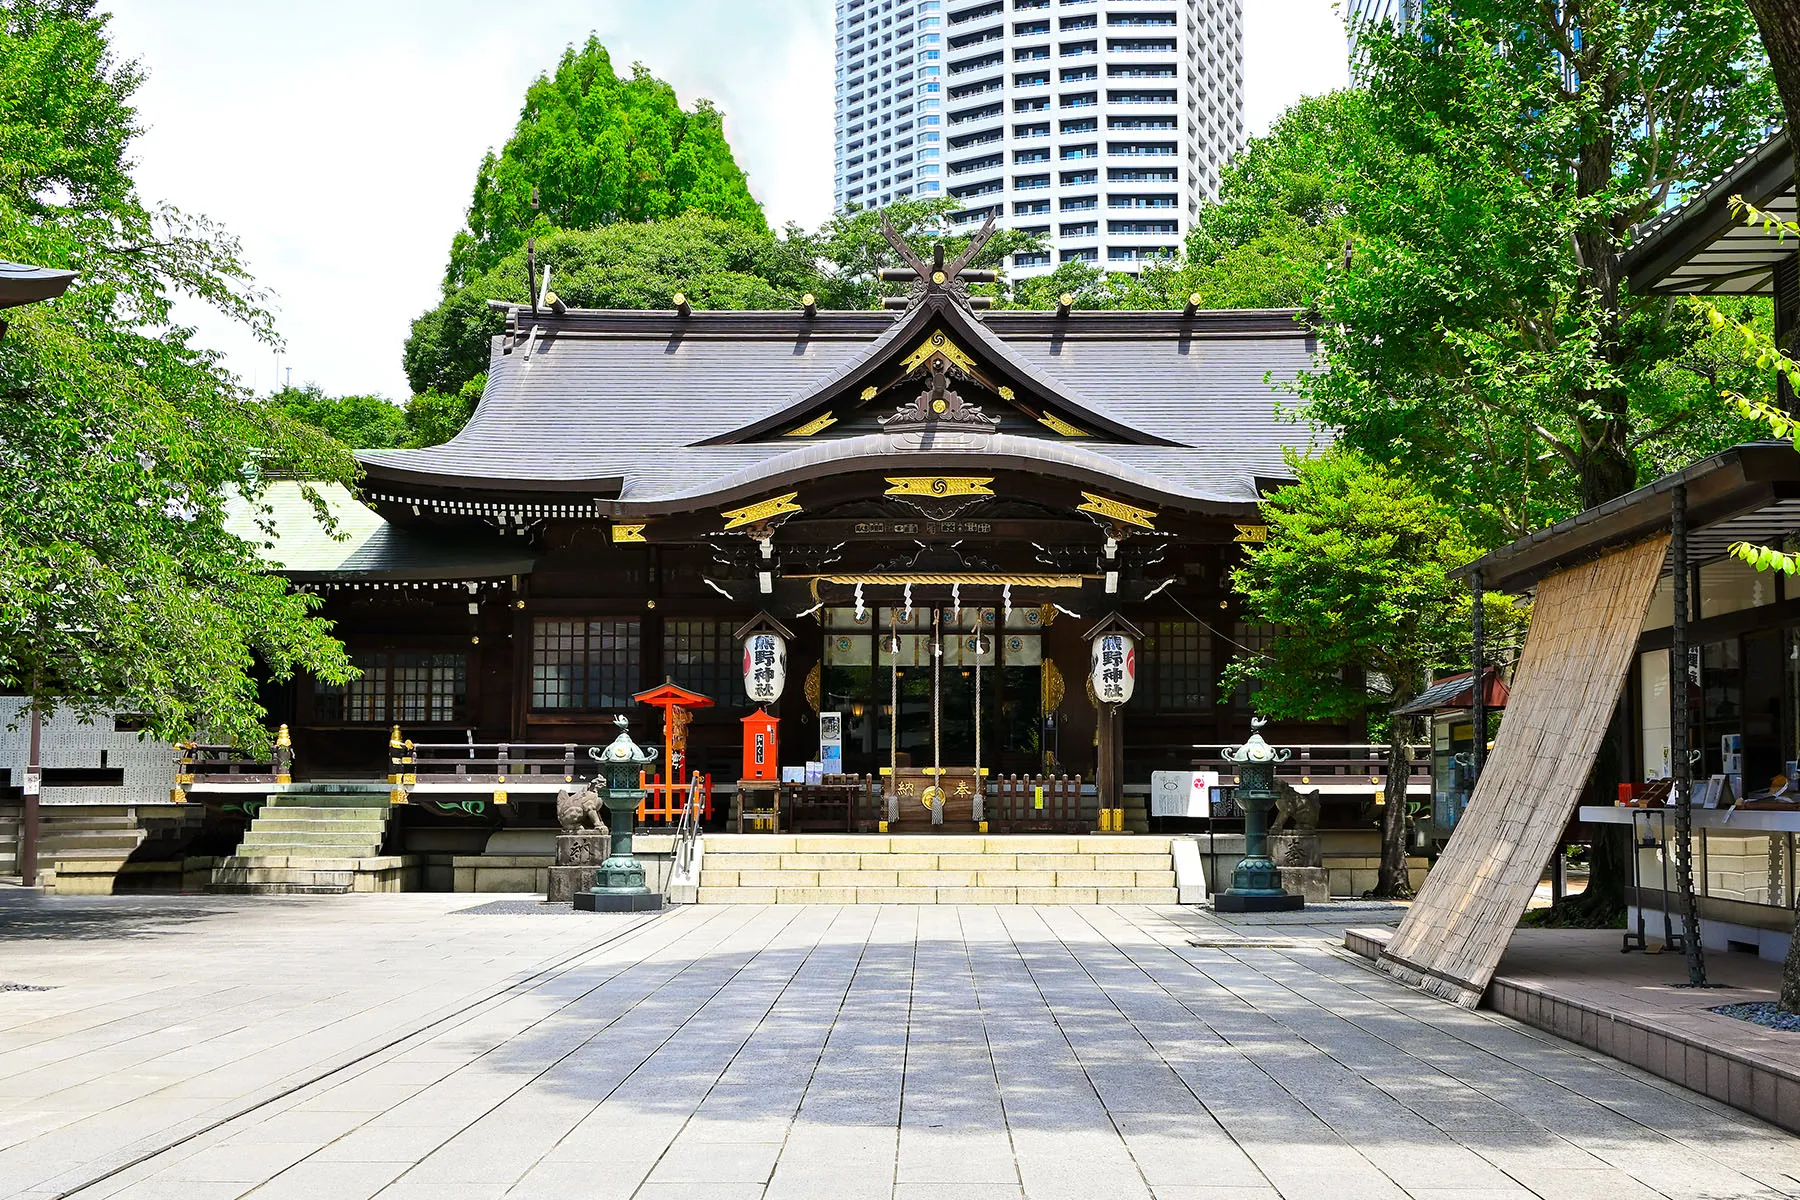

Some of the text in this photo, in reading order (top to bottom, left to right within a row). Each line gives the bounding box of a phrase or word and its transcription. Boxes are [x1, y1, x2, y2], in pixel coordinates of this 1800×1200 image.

[754, 635, 775, 697] 熊野神社
[1102, 636, 1124, 698] 熊野神社
[896, 781, 915, 797] 納
[952, 779, 972, 799] 奉
